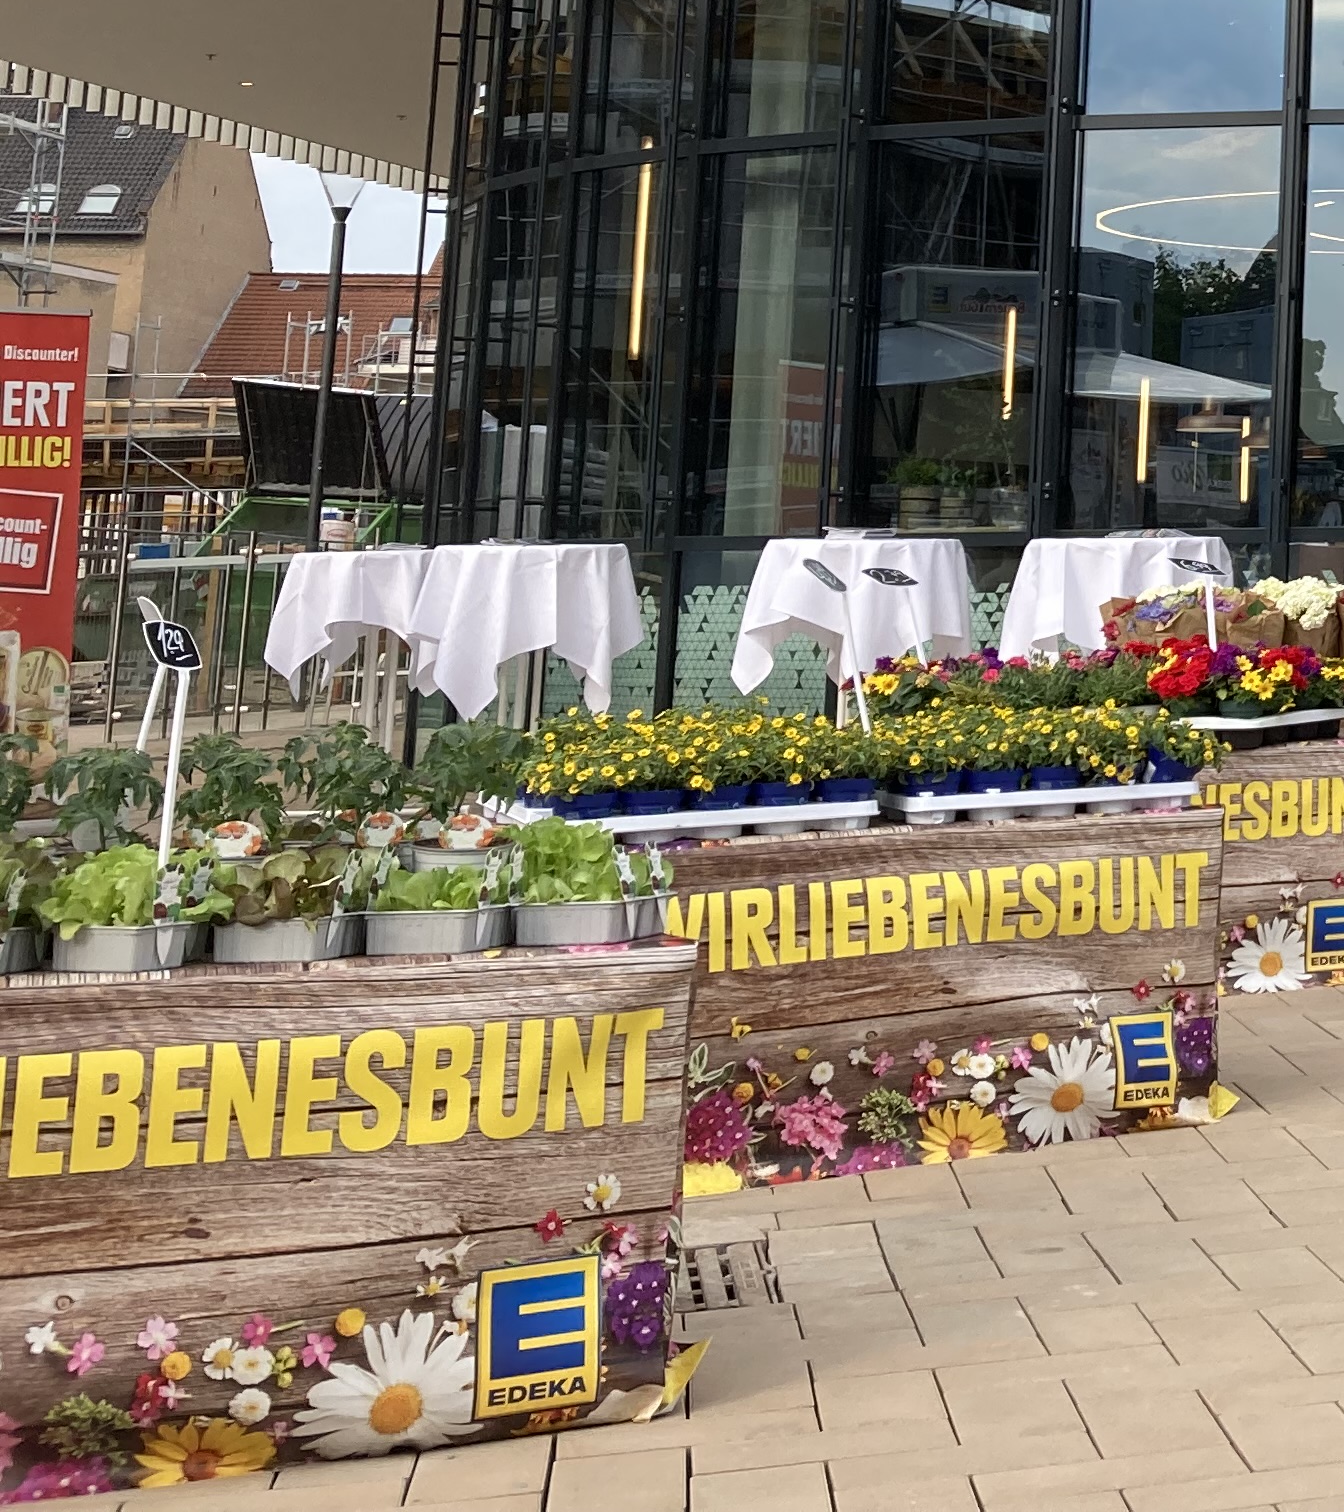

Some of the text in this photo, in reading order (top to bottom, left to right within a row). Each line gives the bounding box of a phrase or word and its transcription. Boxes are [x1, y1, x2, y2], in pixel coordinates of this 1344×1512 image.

[4, 345, 79, 362] Discounter!
[3, 380, 76, 427] ERT
[1117, 1021, 1170, 1084] E
[1123, 1087, 1170, 1102] EDEKA
[489, 1270, 586, 1380] E
[487, 1376, 587, 1408] EDEKA
